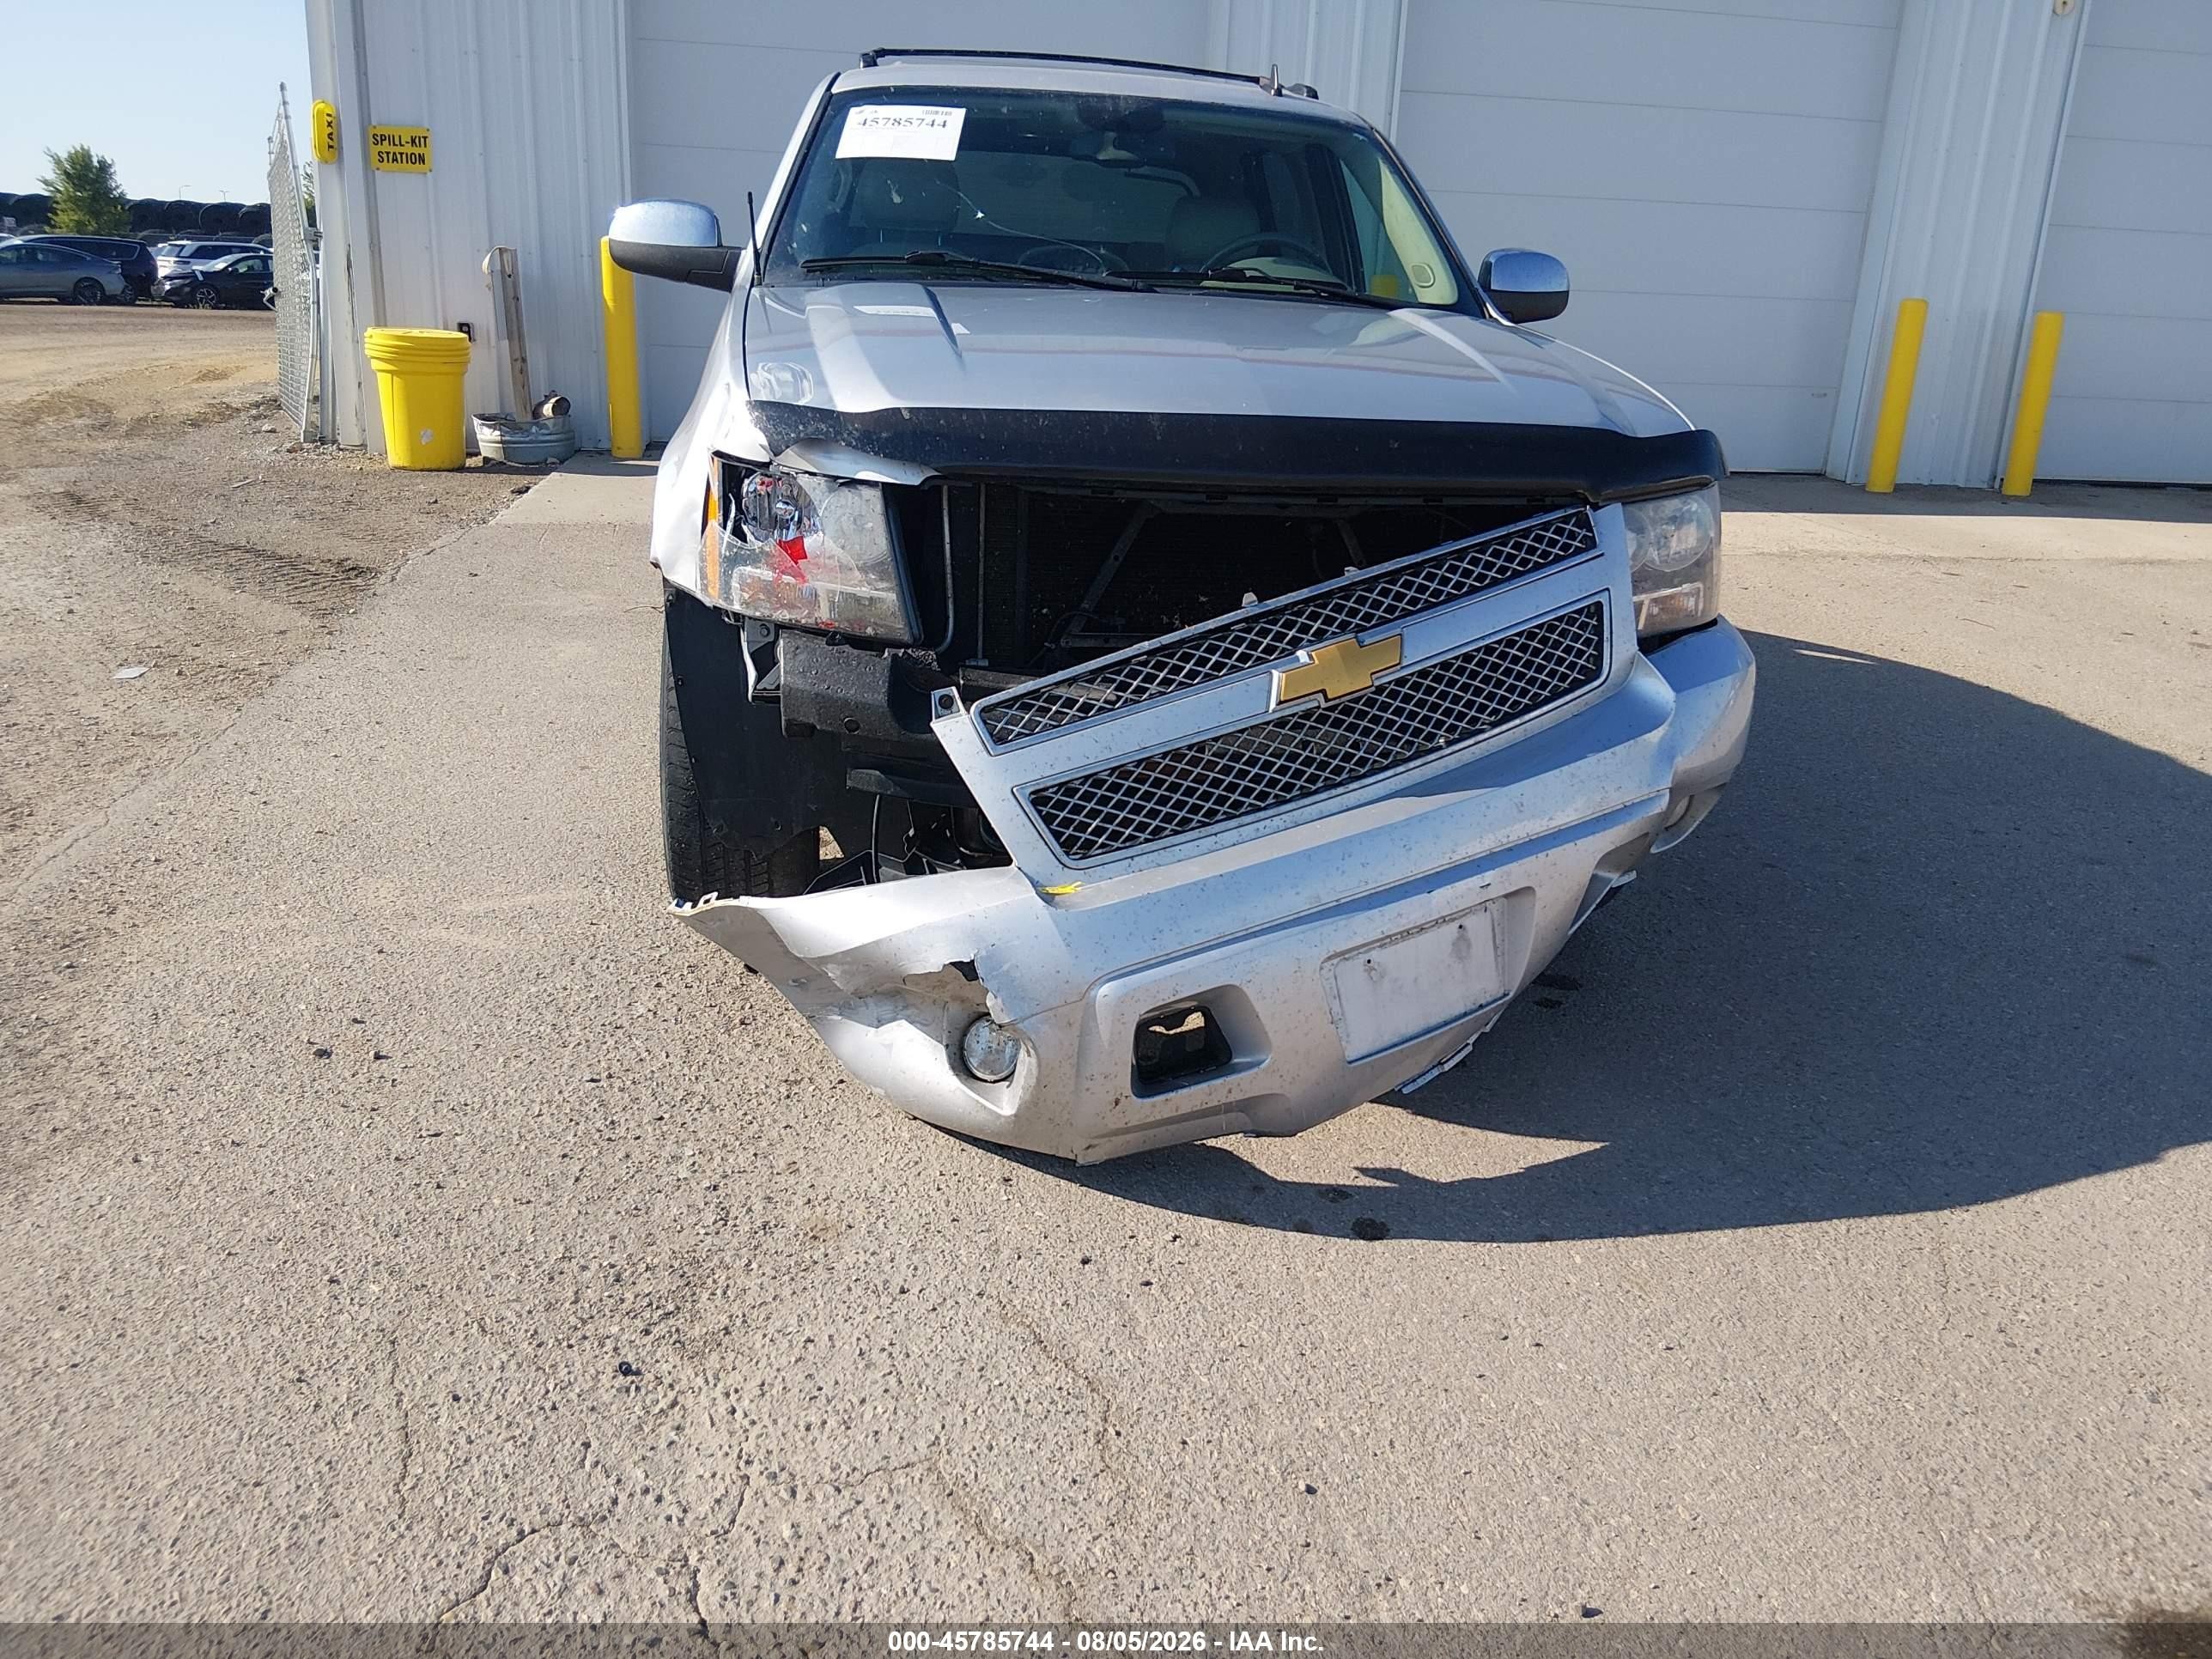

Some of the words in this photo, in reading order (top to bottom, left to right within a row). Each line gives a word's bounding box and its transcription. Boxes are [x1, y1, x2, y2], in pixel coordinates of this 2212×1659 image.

[857, 117, 948, 128] 45785744
[326, 112, 335, 151] TAXI
[372, 133, 428, 148] SPILL-KIT
[377, 151, 426, 165] STATION
